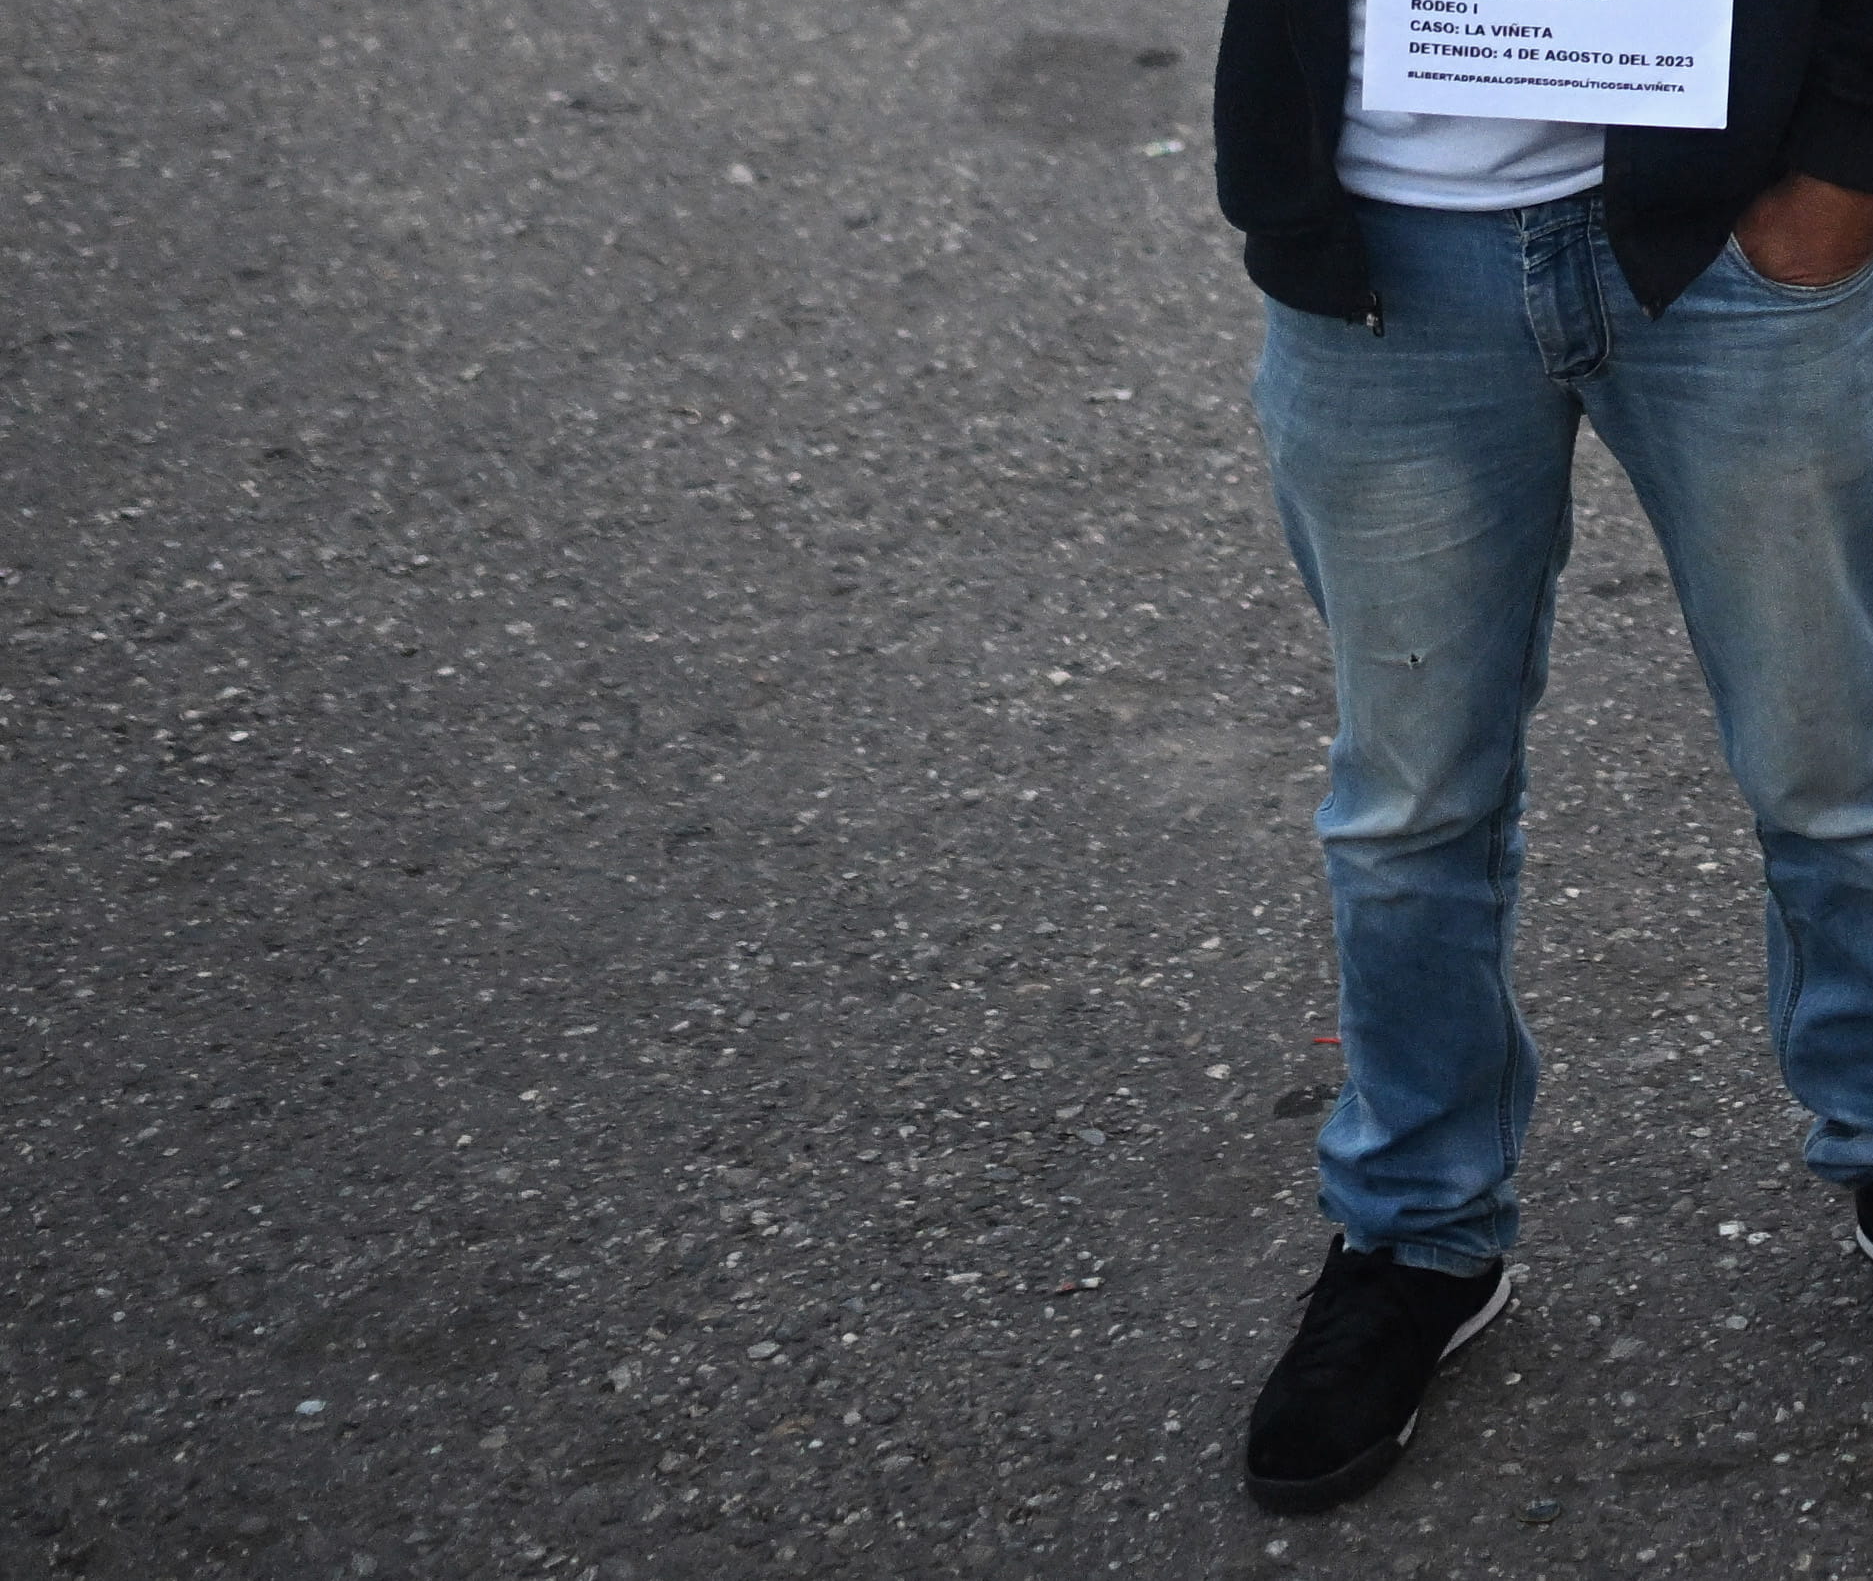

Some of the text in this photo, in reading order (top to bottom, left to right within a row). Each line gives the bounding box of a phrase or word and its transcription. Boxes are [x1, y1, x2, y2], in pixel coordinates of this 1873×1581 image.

[1411, 0, 1478, 15] RODEO I
[1410, 20, 1553, 39] CASO: LA VIÑETA
[1409, 42, 1694, 68] DETENIDO: 4 DE AGOSTO DEL 2023
